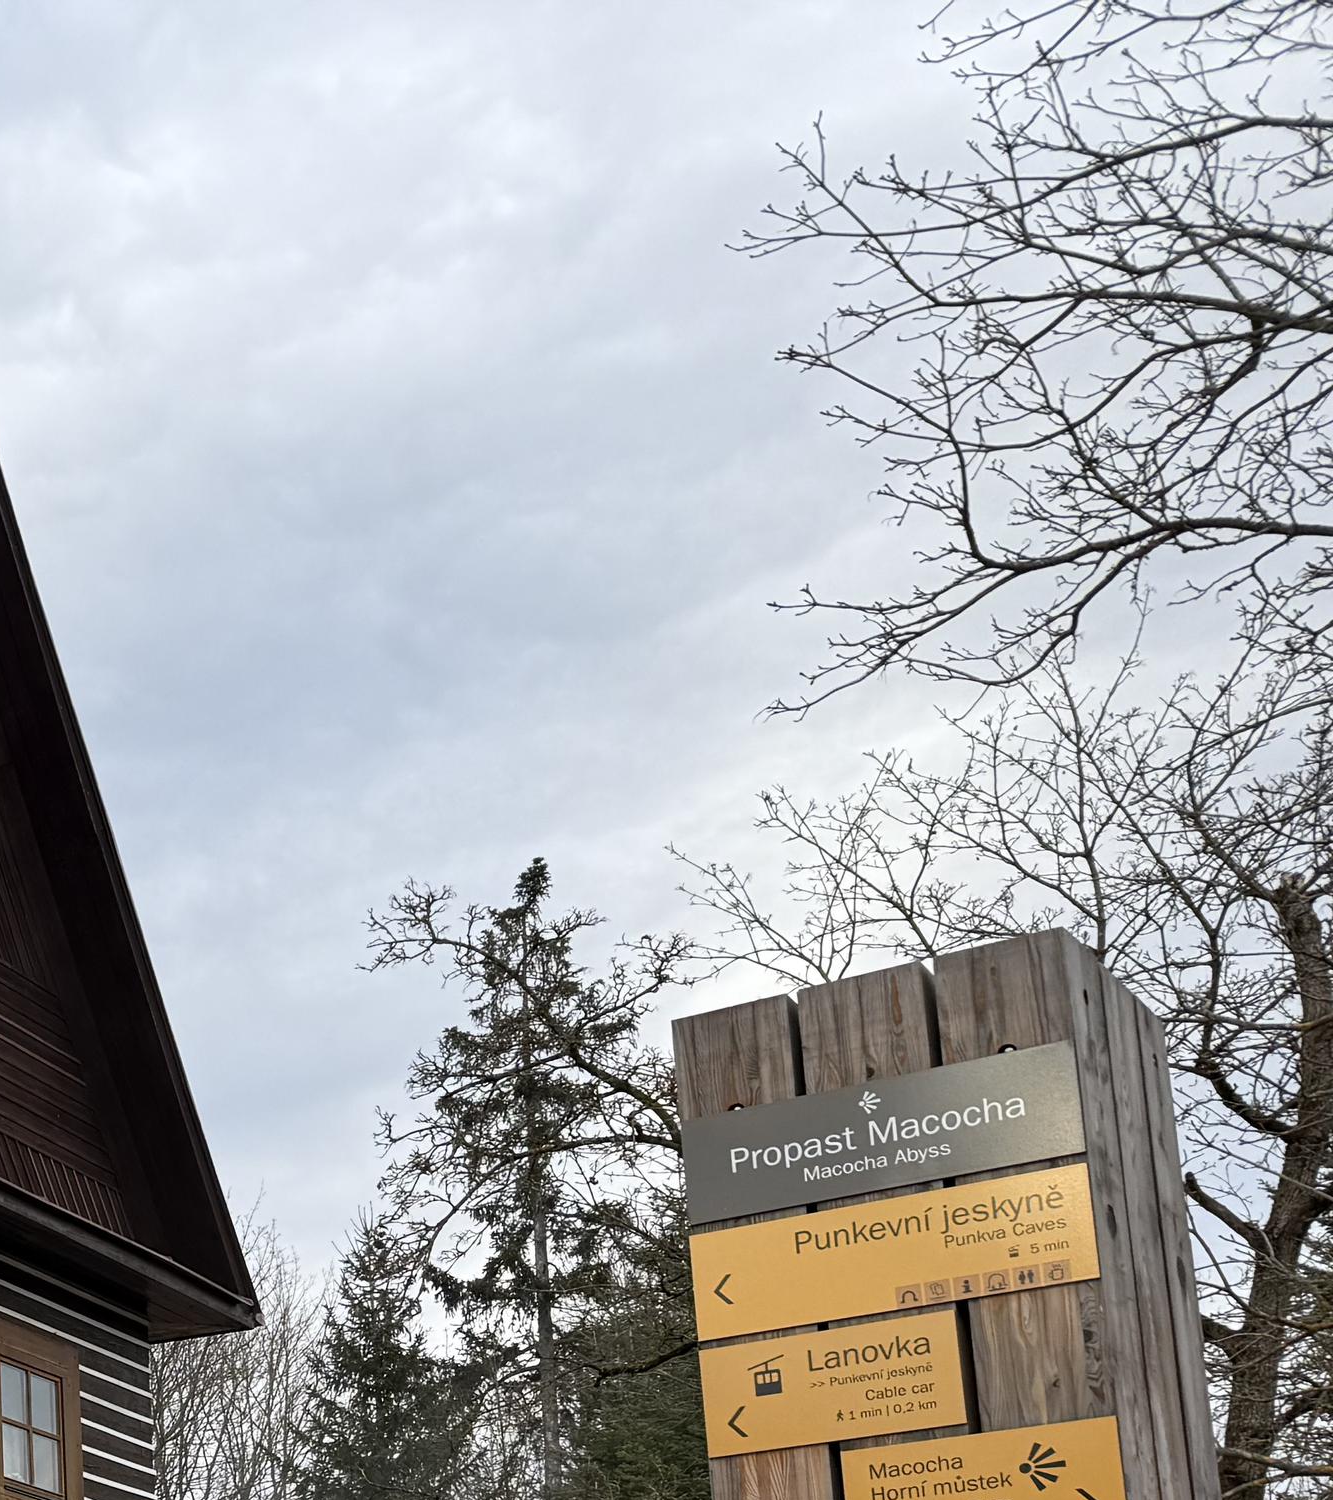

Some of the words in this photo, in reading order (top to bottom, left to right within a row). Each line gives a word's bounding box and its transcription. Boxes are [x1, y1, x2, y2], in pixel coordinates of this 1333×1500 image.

[729, 1127, 857, 1173] Propast
[868, 1096, 1026, 1146] Macocha
[803, 1153, 888, 1182] Macocha
[894, 1143, 951, 1166] Abyss
[795, 1206, 933, 1254] Punkevní
[941, 1185, 1064, 1233] jeskyně
[944, 1228, 1006, 1248] Punkva
[1012, 1217, 1067, 1236] Caves
[1030, 1243, 1040, 1254] 5
[1043, 1239, 1069, 1253] min
[807, 1335, 931, 1372] Lanovka
[829, 1370, 883, 1387] Punkevní
[865, 1386, 906, 1401] Cable
[911, 1382, 935, 1395] car
[849, 1410, 856, 1420] 1
[860, 1407, 882, 1419] min
[918, 1399, 937, 1411] km
[869, 1456, 963, 1480] Macocha
[933, 1472, 1013, 1496] můstek
